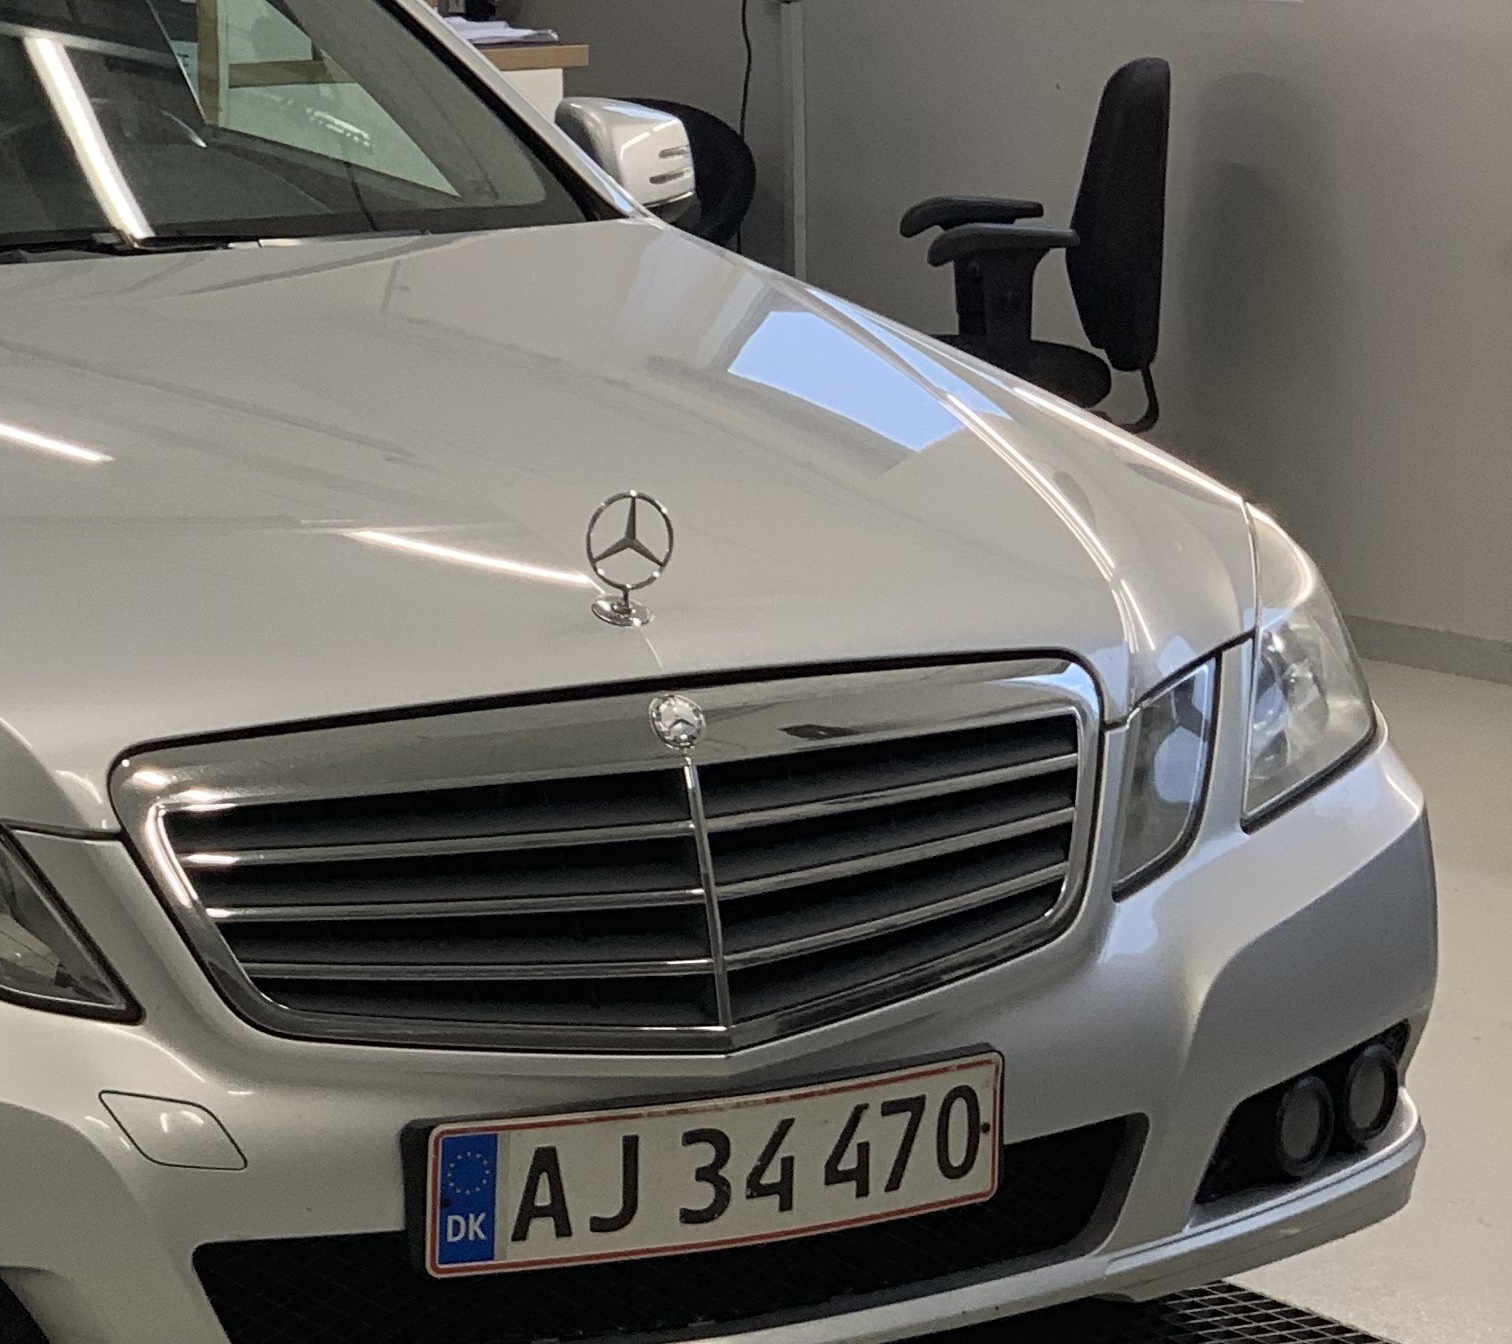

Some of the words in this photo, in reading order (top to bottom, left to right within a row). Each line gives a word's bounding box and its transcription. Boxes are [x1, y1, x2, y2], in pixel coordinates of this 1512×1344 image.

[511, 1134, 640, 1243] AJ
[678, 1117, 796, 1225] 34
[823, 1084, 982, 1199] 470
[445, 1212, 487, 1244] DK
